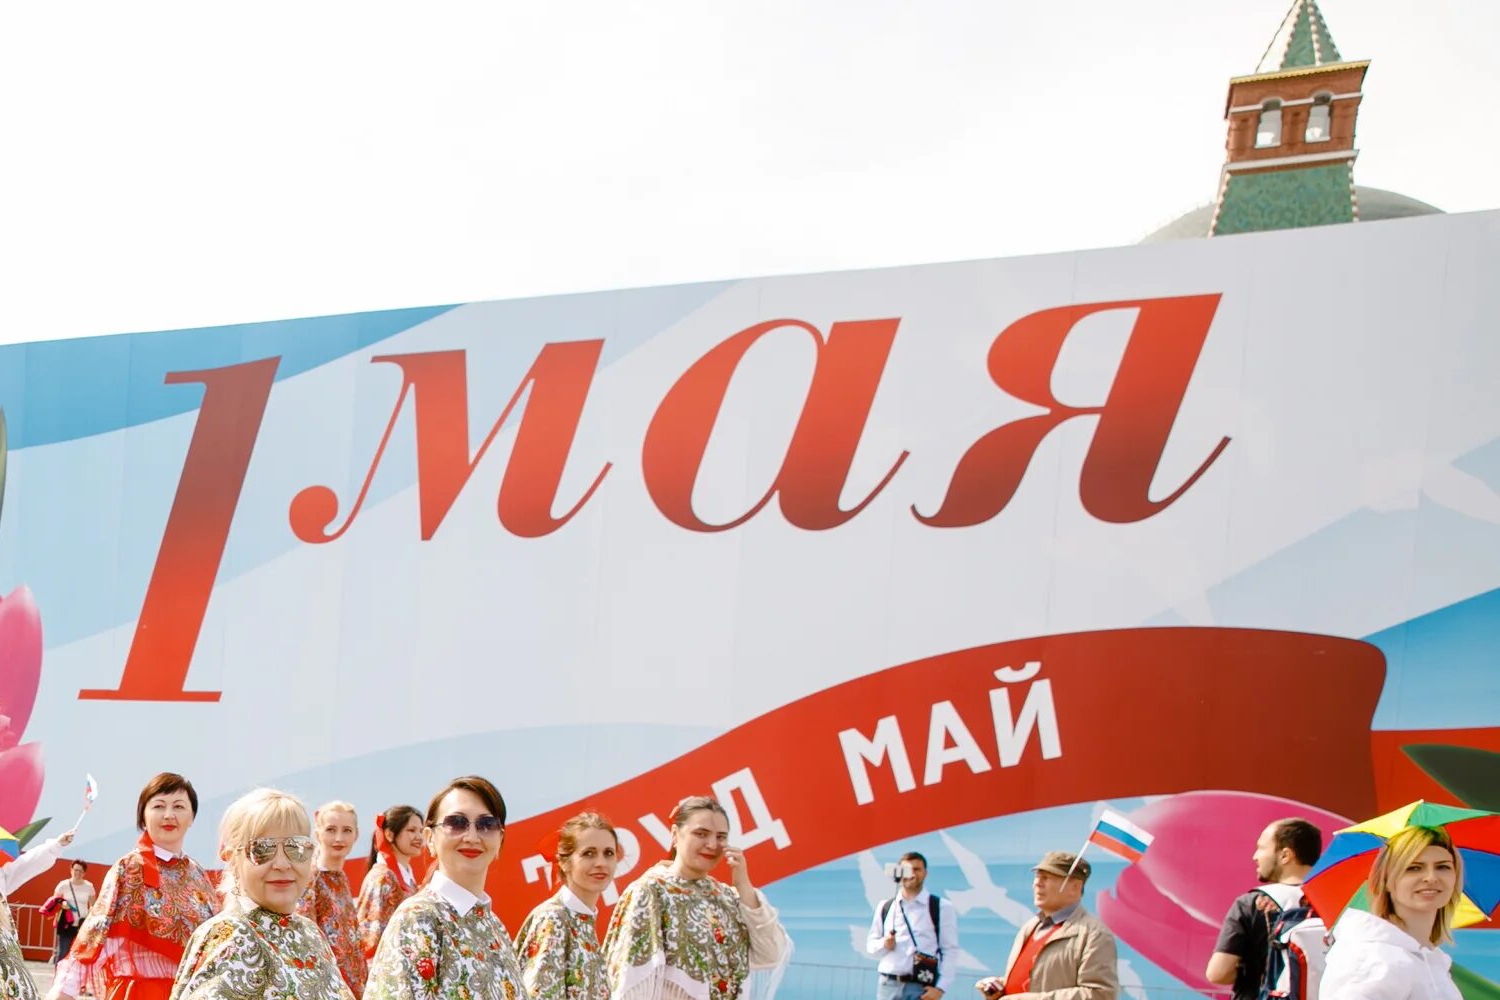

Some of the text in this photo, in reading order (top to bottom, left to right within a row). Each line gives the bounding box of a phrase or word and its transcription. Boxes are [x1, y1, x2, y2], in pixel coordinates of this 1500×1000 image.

[77, 292, 1229, 704] 1 мая
[838, 661, 1062, 806] МАЙ
